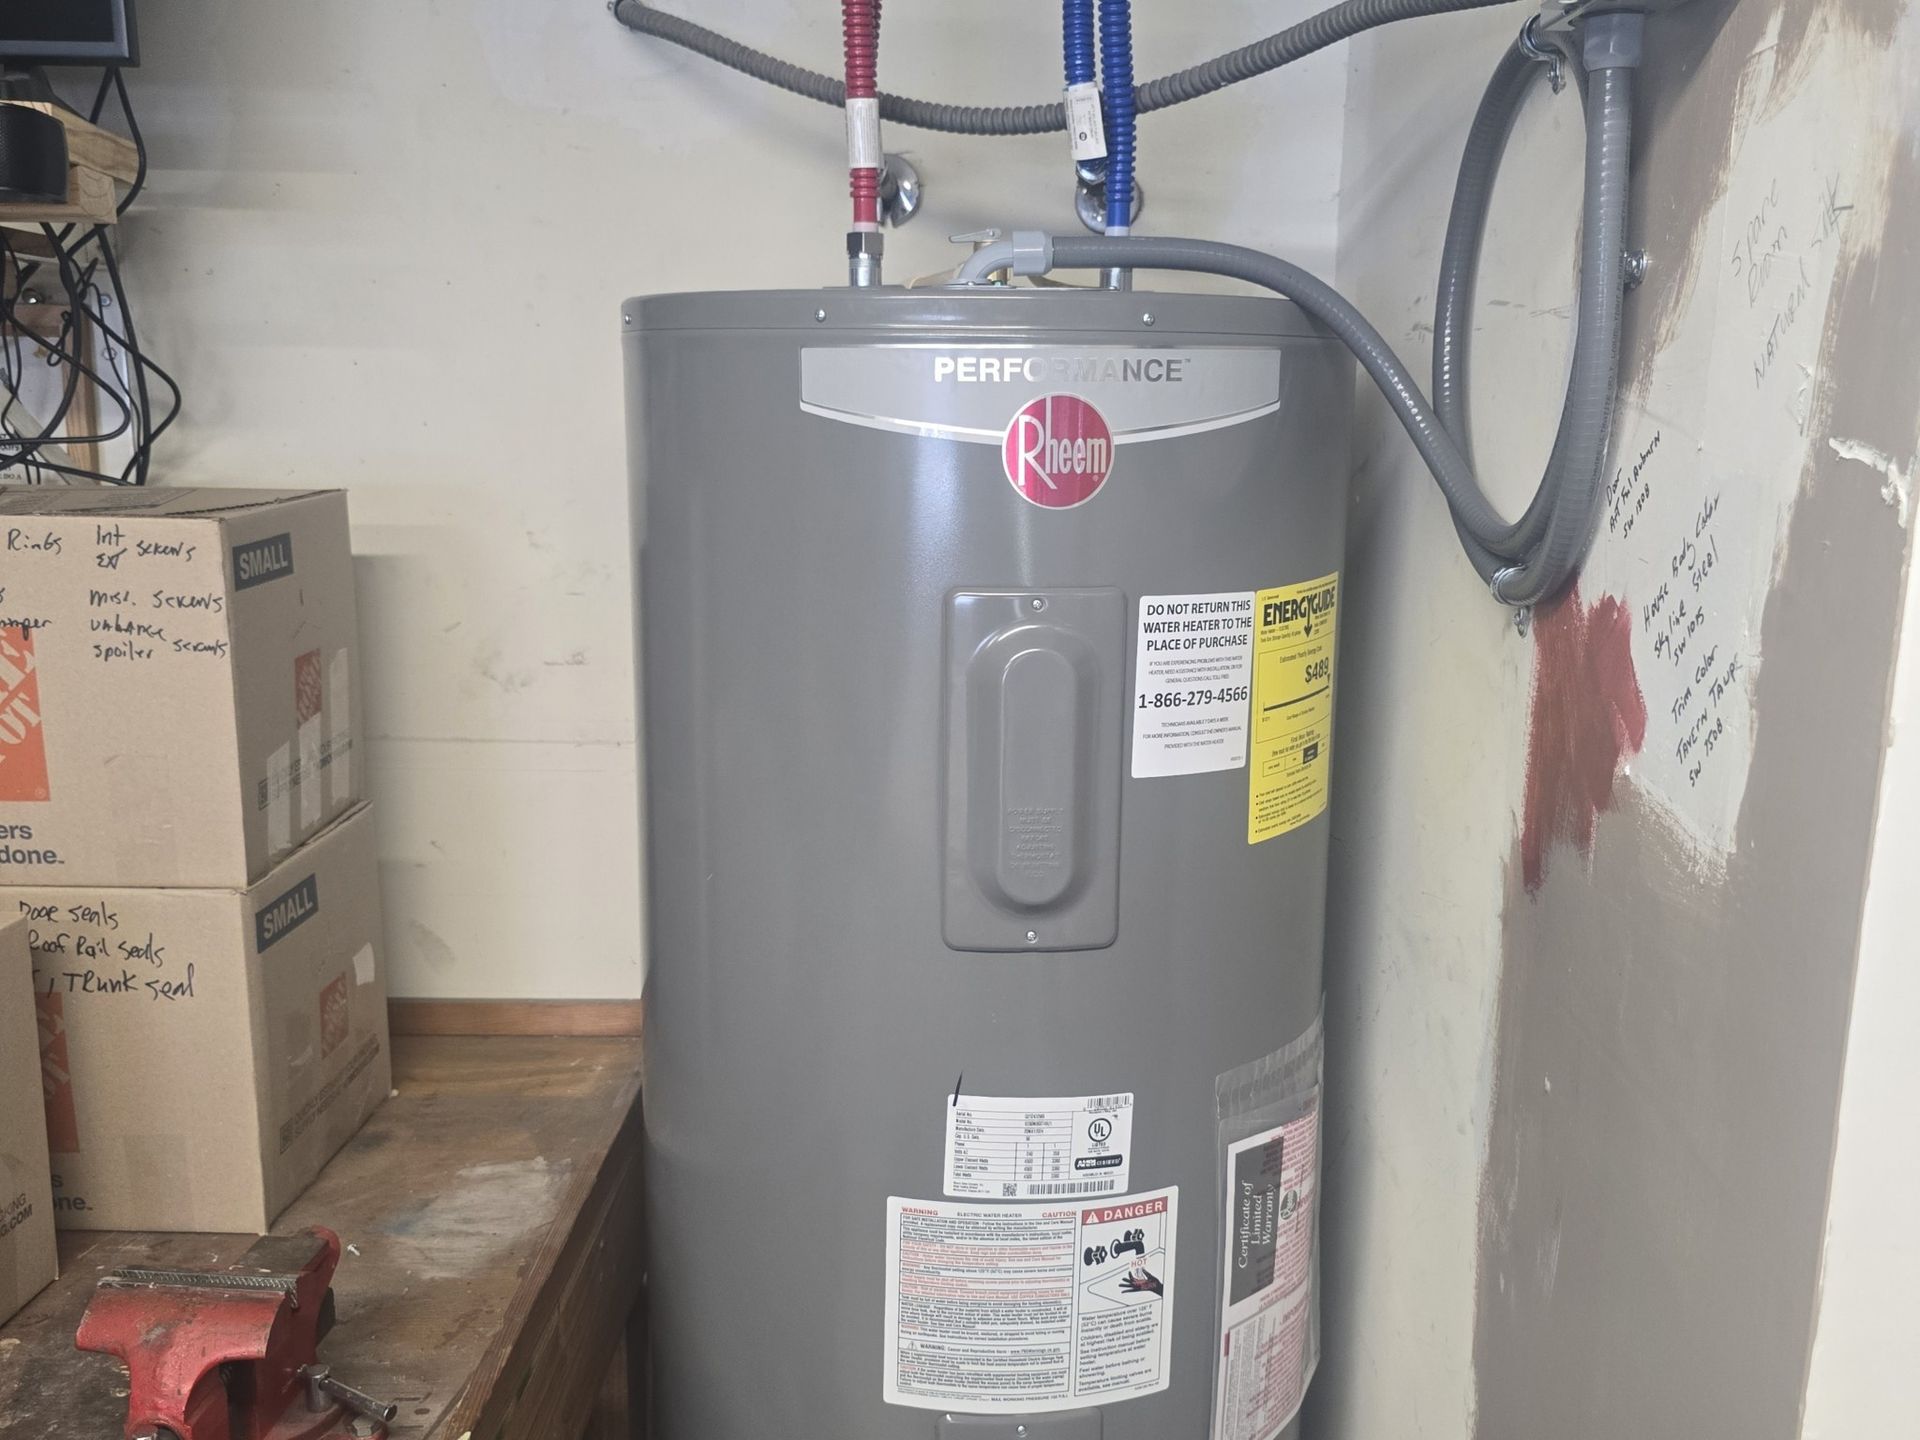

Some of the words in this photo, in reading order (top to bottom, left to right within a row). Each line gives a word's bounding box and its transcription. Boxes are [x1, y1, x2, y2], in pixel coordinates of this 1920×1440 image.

[933, 357, 1184, 383] PERFORMANCE
[1017, 396, 1107, 489] Rheem
[239, 544, 288, 580] SMALL
[1147, 605, 1164, 616] DO
[1167, 604, 1189, 615] NOT
[1191, 601, 1229, 614] RETURN
[1232, 600, 1250, 612] THIS
[1263, 585, 1336, 628] ENERGYGUIDE
[1144, 622, 1180, 633] WATER
[1183, 619, 1220, 632] HEATER
[1222, 618, 1233, 630] TO
[1236, 617, 1252, 628] THE
[1147, 639, 1180, 651] PLACE
[1183, 638, 1196, 649] OF
[1199, 635, 1247, 648] PURCHASE
[1304, 656, 1329, 683] $489
[1138, 686, 1248, 709] 1-866-279-4566
[263, 887, 314, 940] SMALL
[1094, 1122, 1106, 1137] UL
[1242, 1180, 1254, 1195] of
[901, 1207, 939, 1216] WARNING
[1042, 1210, 1077, 1218] CAUTION
[1104, 1201, 1163, 1221] DANGER
[1250, 1194, 1263, 1245] Limited
[1262, 1183, 1276, 1245] Warranty
[1238, 1199, 1251, 1269] Certificate
[1130, 1258, 1148, 1268] HOT
